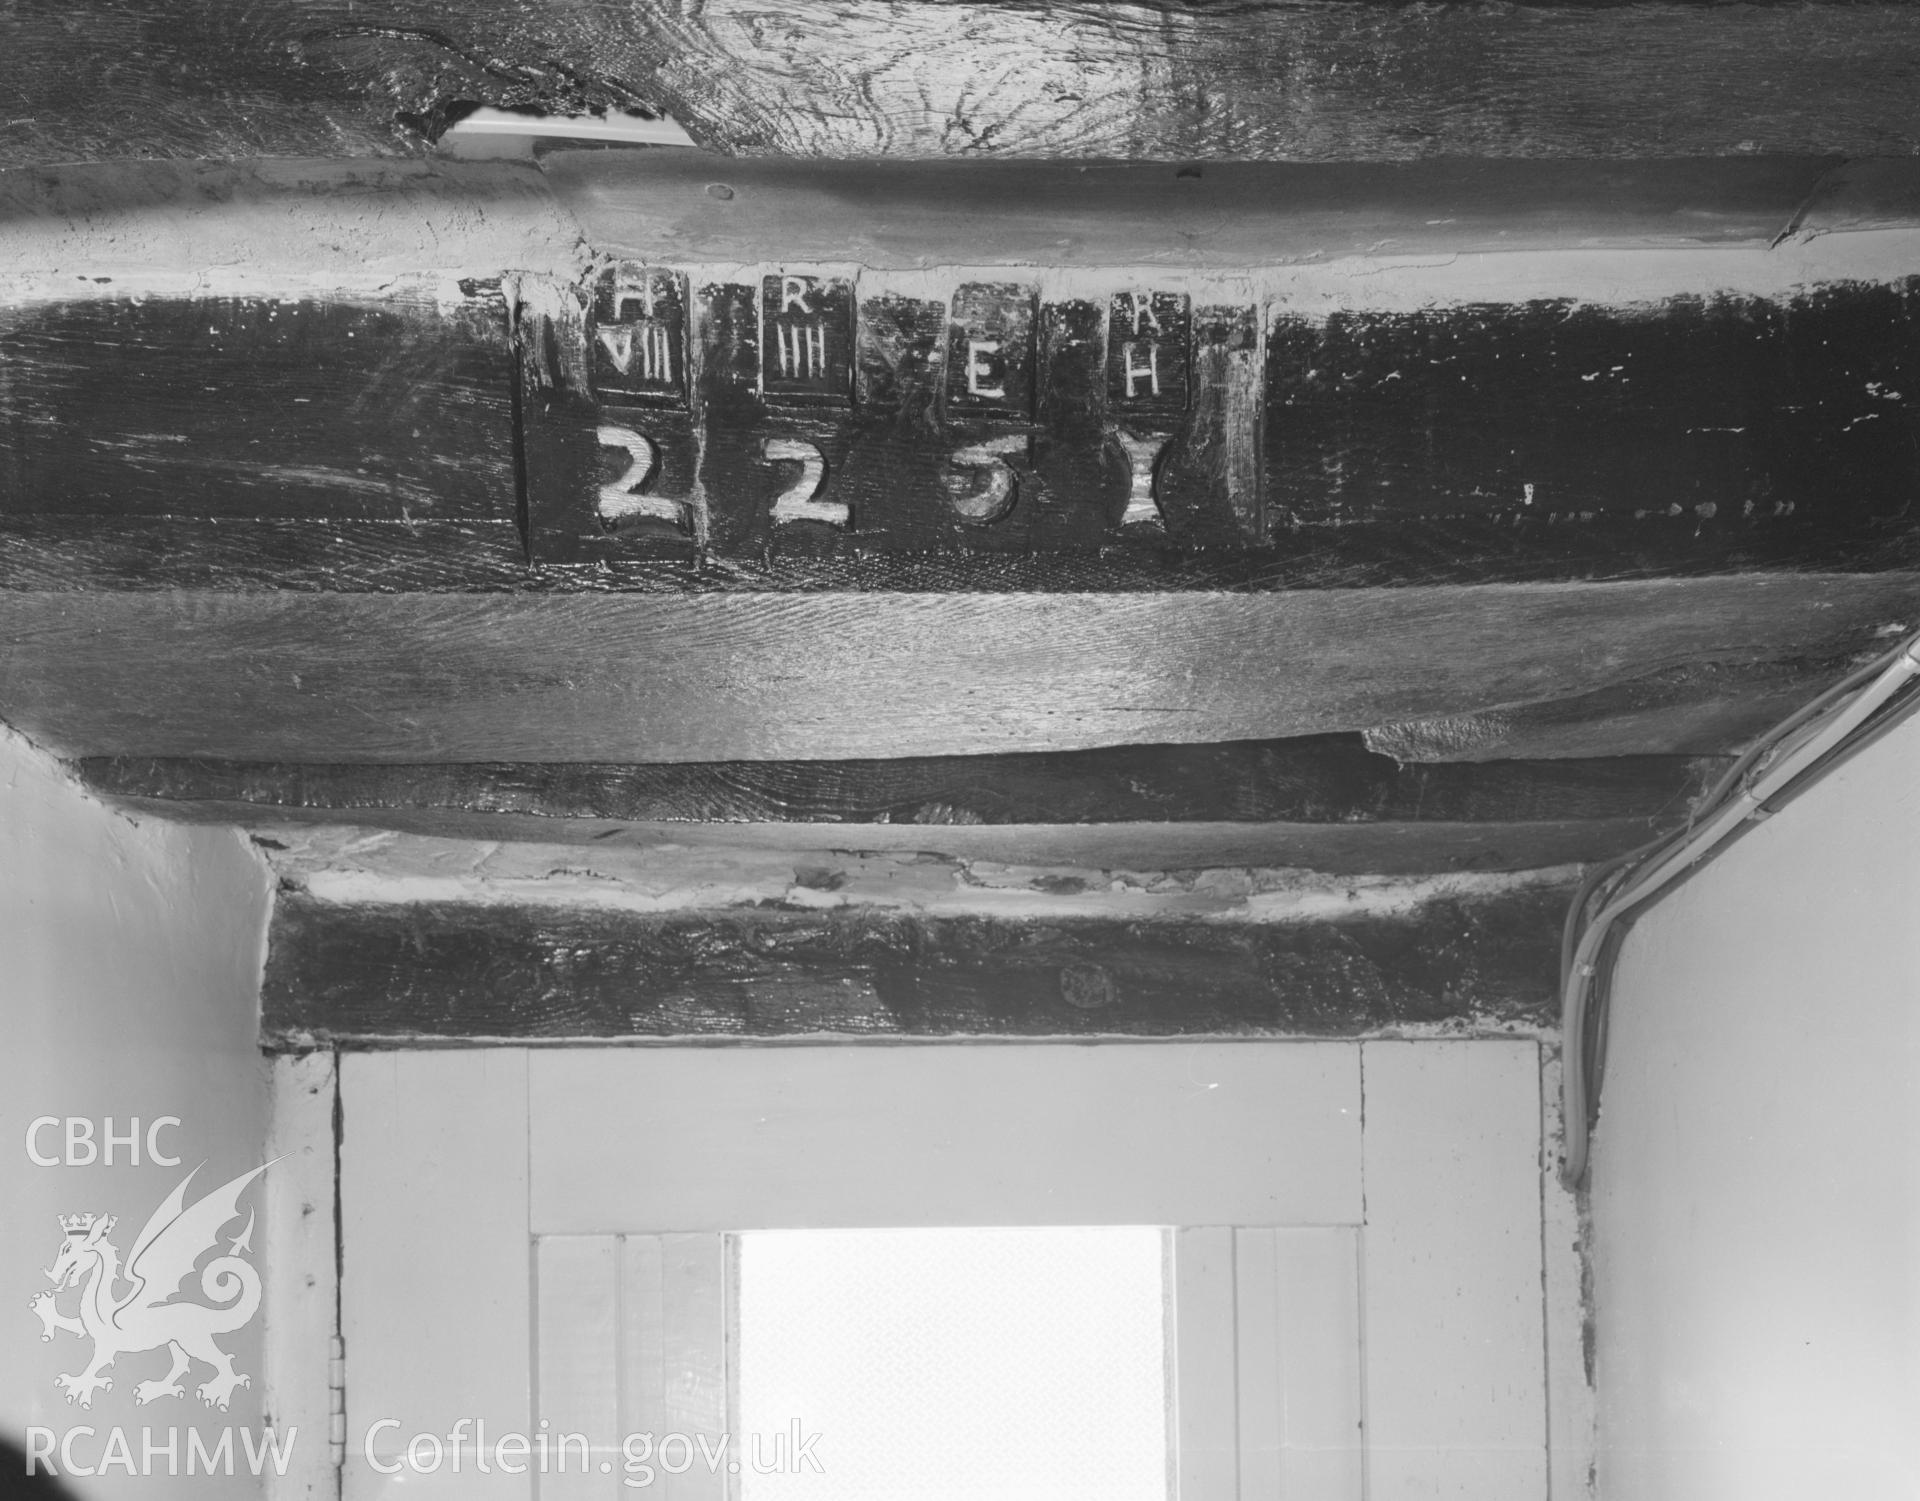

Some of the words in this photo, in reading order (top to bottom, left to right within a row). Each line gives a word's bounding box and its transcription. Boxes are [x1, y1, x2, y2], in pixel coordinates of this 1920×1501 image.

[781, 276, 814, 313] R
[597, 326, 672, 383] VIII
[967, 341, 1006, 398] E
[1122, 342, 1160, 398] H
